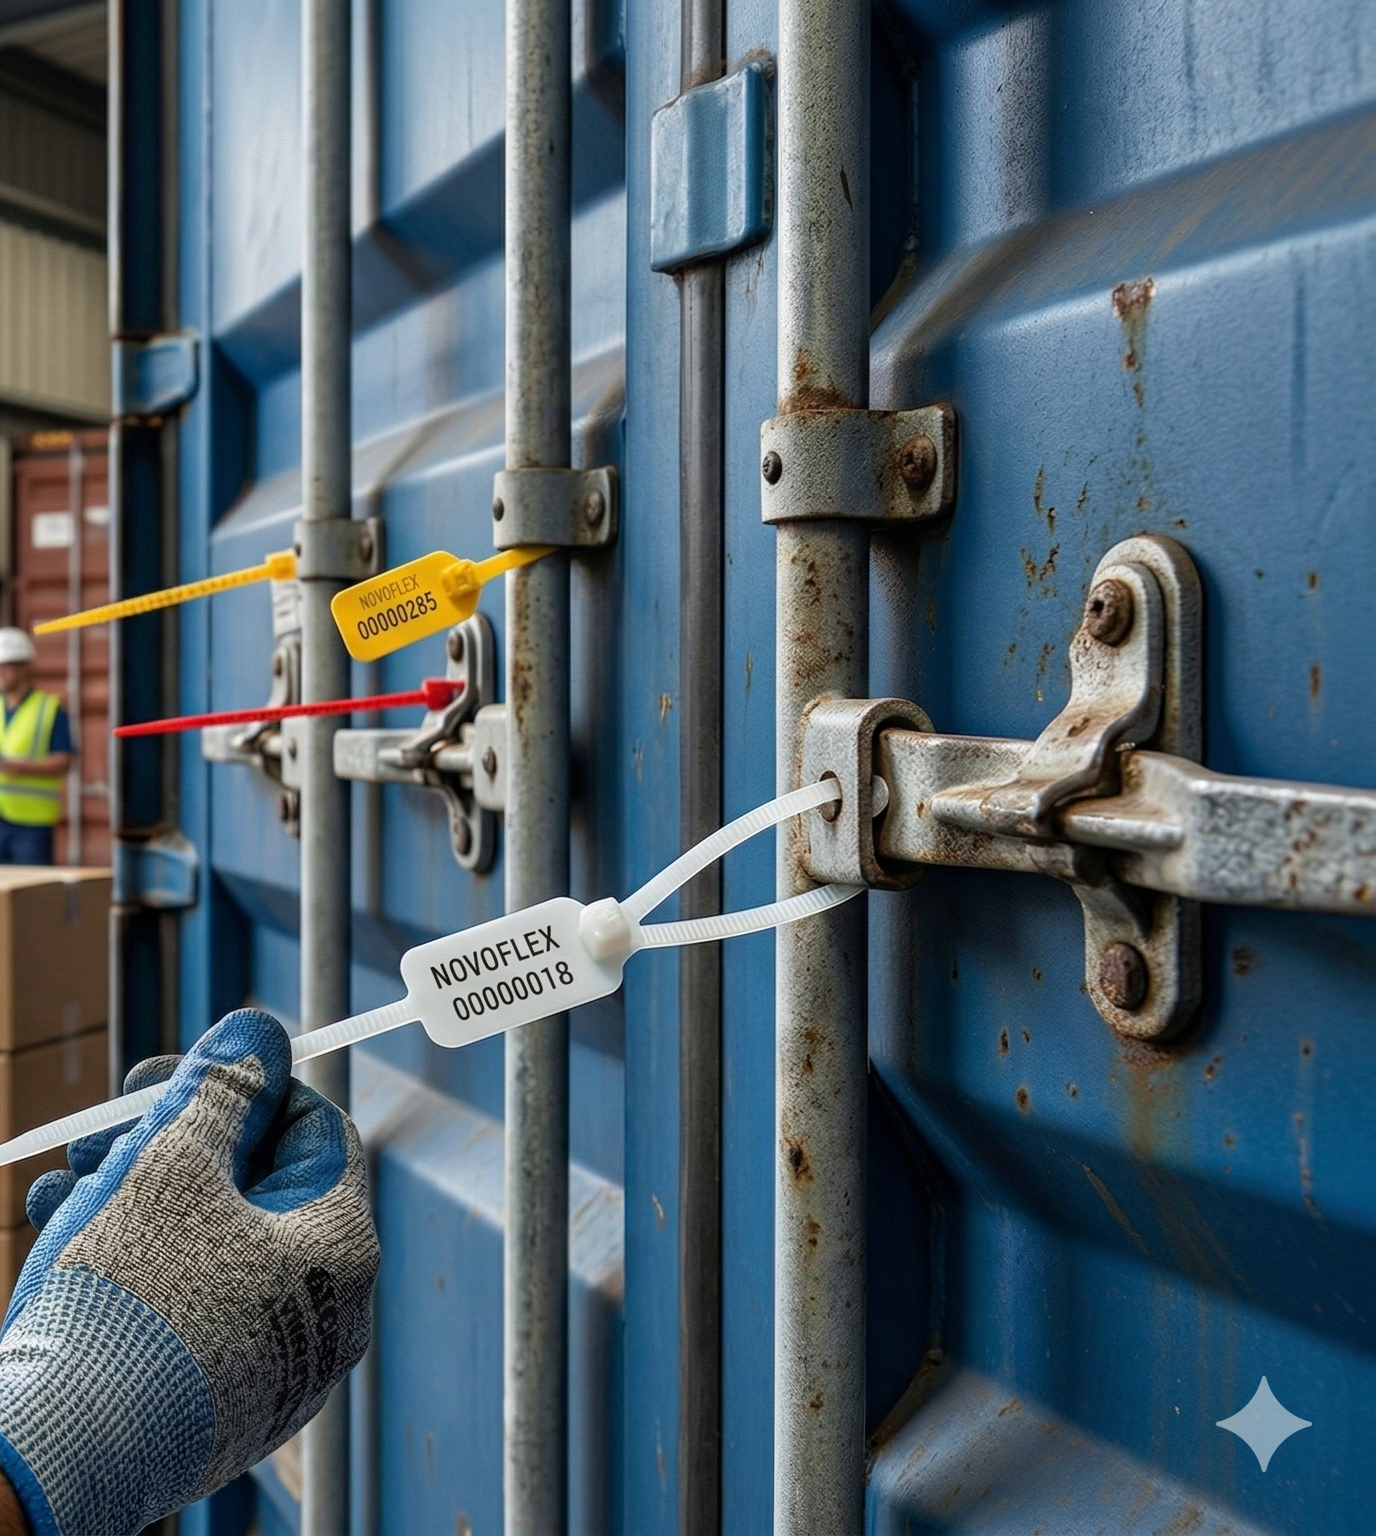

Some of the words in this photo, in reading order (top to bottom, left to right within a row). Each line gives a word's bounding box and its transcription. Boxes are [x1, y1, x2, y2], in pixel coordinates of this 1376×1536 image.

[357, 591, 437, 640] 00000285
[359, 574, 420, 610] NOVOFLEX
[430, 925, 560, 989] NOVOFLEX
[453, 961, 574, 1020] 00000018
